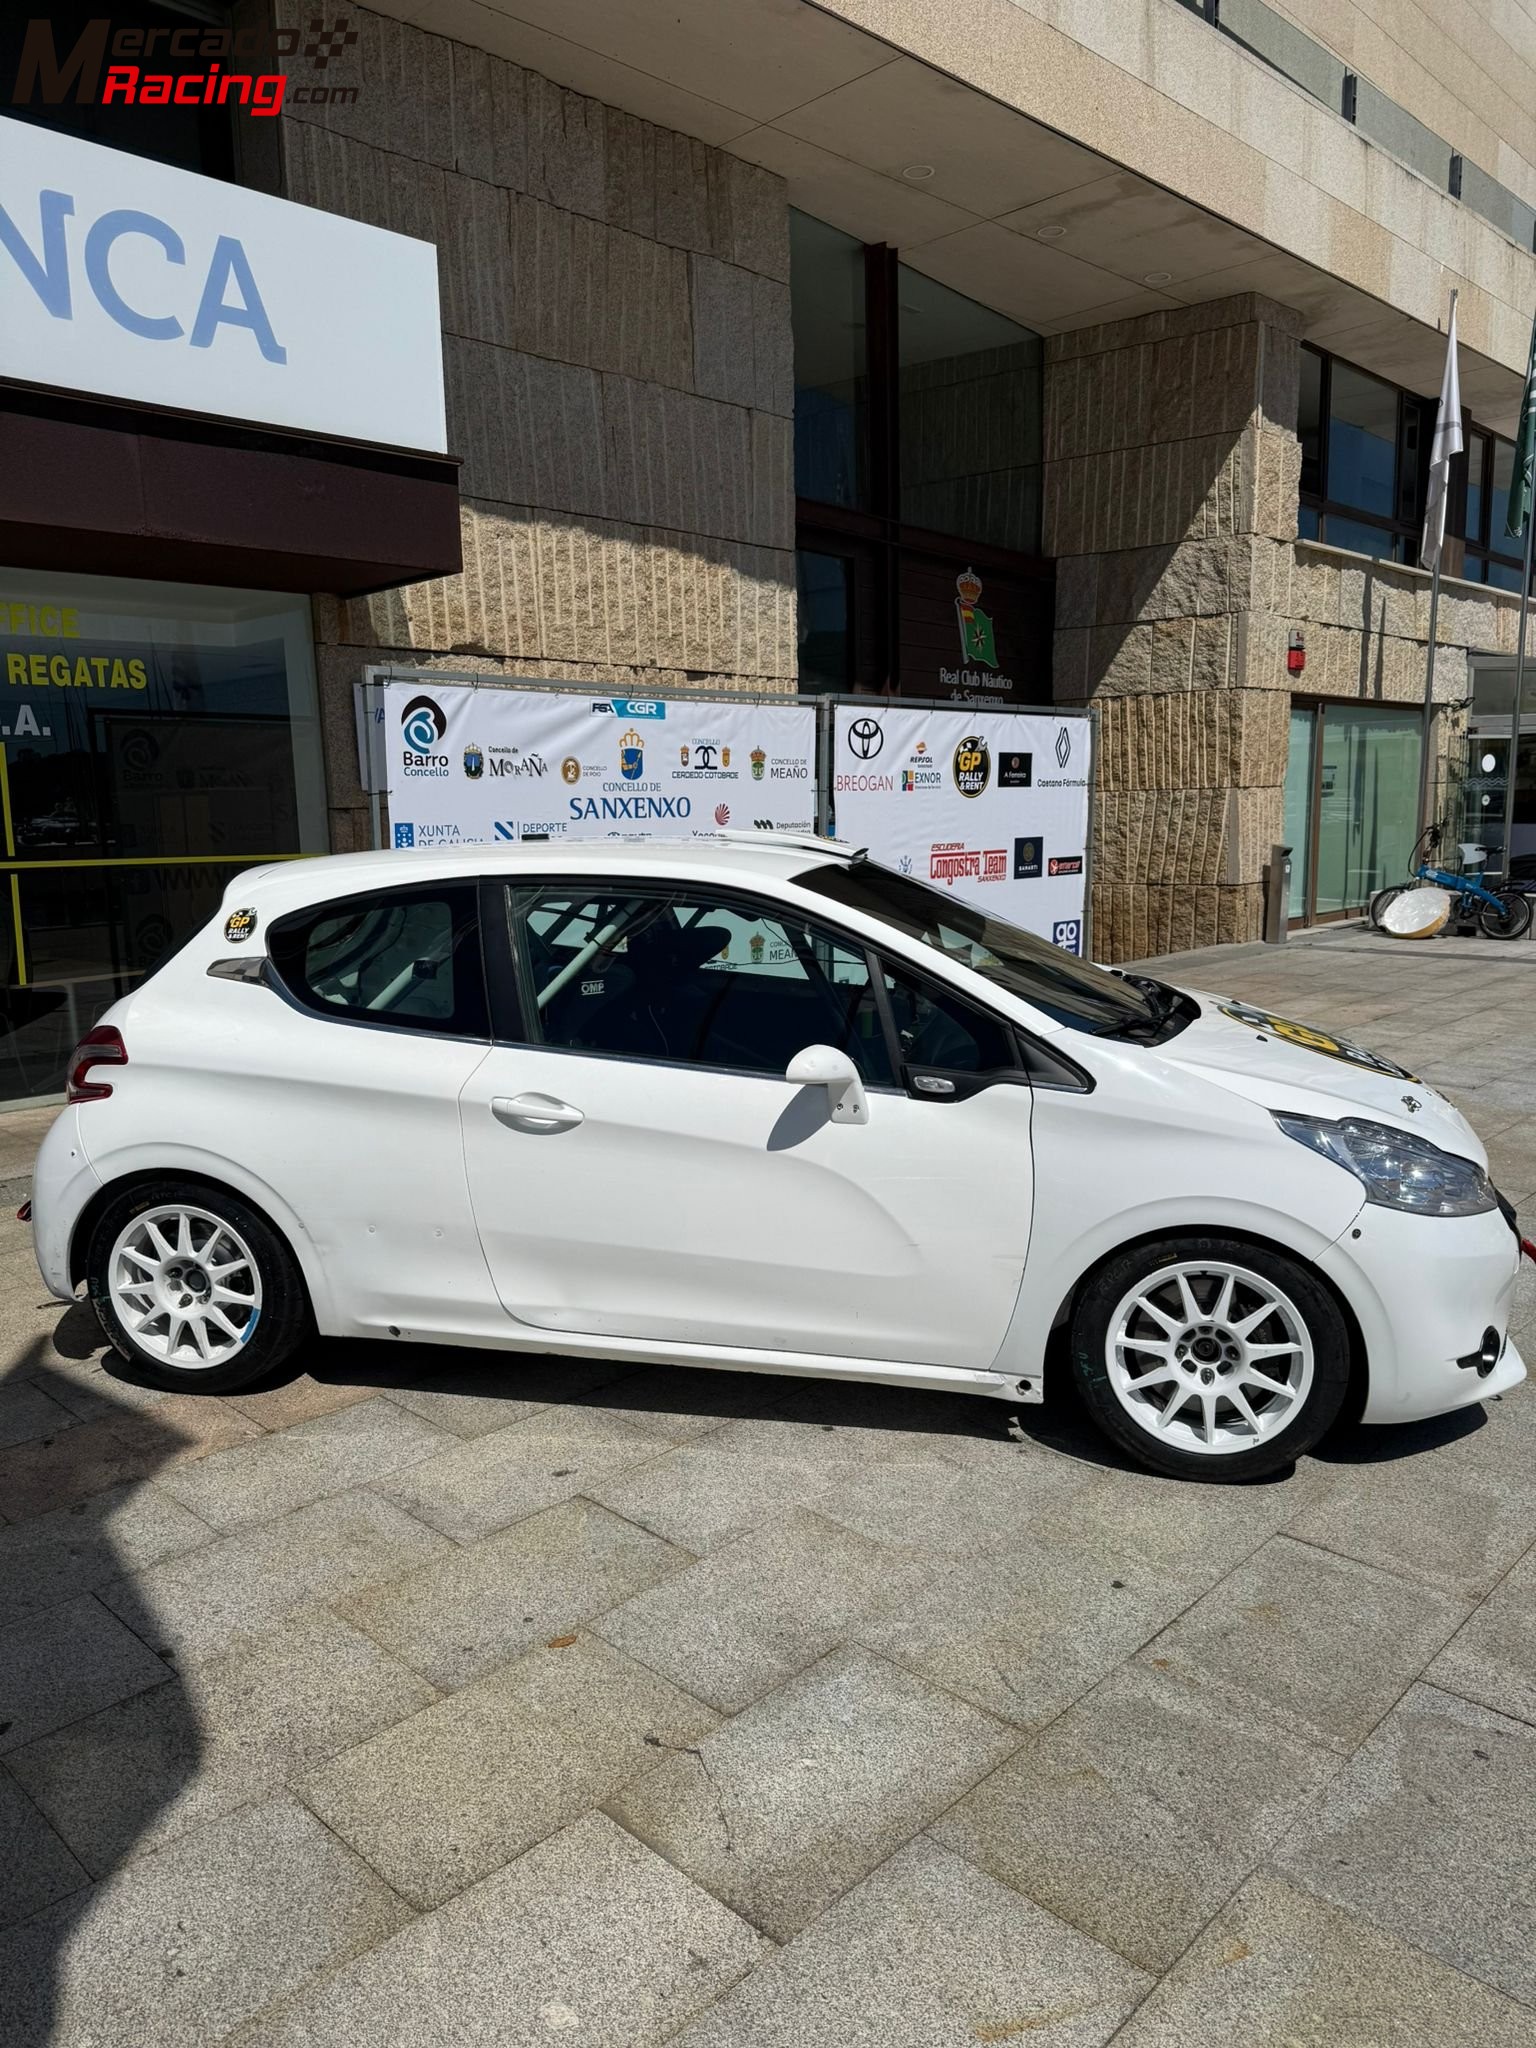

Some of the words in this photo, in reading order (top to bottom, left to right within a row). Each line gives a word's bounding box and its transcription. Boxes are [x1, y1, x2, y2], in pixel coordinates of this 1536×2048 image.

[6, 653, 147, 689] REGATAS
[939, 667, 960, 684] Real
[961, 670, 980, 687] Club
[981, 672, 1013, 690] Náutico
[626, 701, 657, 715] CGR
[403, 751, 449, 767] Barro
[960, 752, 981, 771] GP
[403, 766, 449, 777] Concello
[770, 765, 808, 779] MEAÑO
[958, 771, 984, 781] RALLY
[602, 781, 648, 792] CONCELLO
[650, 782, 662, 793] DE
[836, 774, 894, 791] BREOGAN
[1037, 778, 1062, 787] Caetano
[569, 797, 691, 820] SANXENXO
[418, 824, 460, 837] XUNTA
[522, 822, 568, 833] DEPORTE
[776, 821, 811, 830] Deputación
[929, 851, 981, 886] Congostra
[982, 849, 1008, 875] Team
[230, 916, 250, 928] GP
[581, 982, 605, 993] OMP
